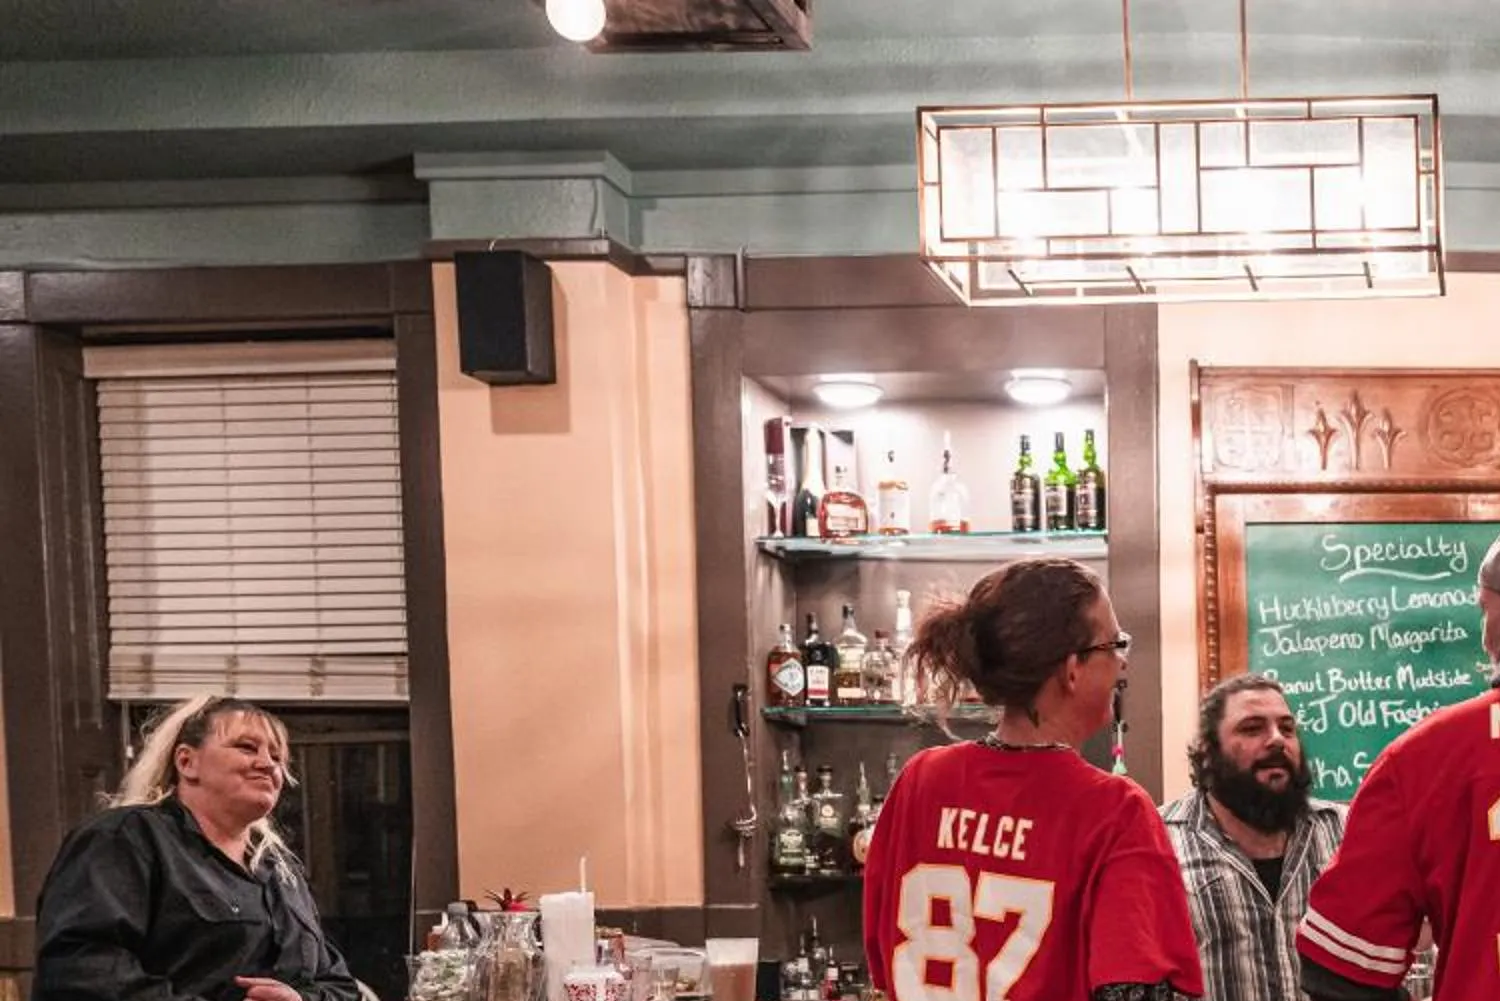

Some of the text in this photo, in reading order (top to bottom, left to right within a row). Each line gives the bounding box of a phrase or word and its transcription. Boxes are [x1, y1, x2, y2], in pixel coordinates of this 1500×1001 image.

[1320, 534, 1468, 573] Specialty
[1258, 585, 1482, 624] Huckleberry Lemonad
[1258, 621, 1468, 656] Jalapeno Margarita
[1262, 668, 1326, 694] Panut
[1327, 667, 1392, 694] Butter
[1396, 663, 1472, 691] Mudslide
[1338, 699, 1378, 728] Old
[937, 807, 1033, 860] KELCE
